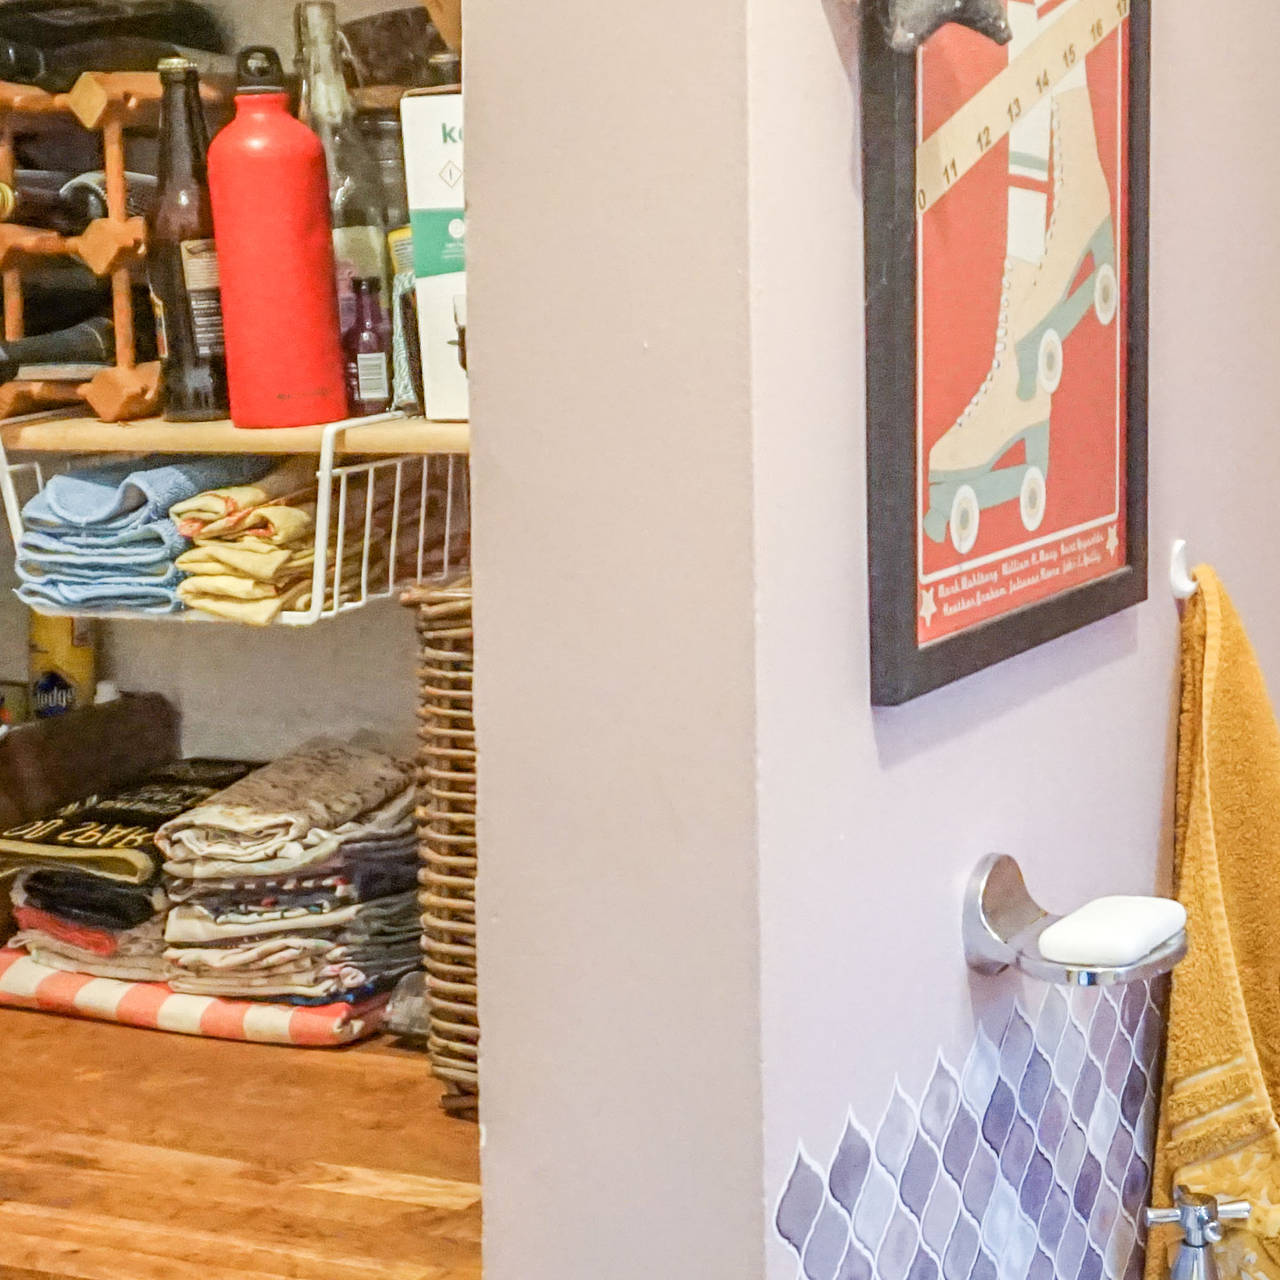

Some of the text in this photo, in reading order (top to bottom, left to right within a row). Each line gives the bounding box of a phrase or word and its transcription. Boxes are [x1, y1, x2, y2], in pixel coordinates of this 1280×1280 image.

[943, 158, 957, 184] 11
[976, 126, 991, 152] 12
[1007, 98, 1022, 123] 13
[1035, 69, 1050, 94] 14
[1063, 43, 1076, 68] 15
[1090, 18, 1103, 42] 16
